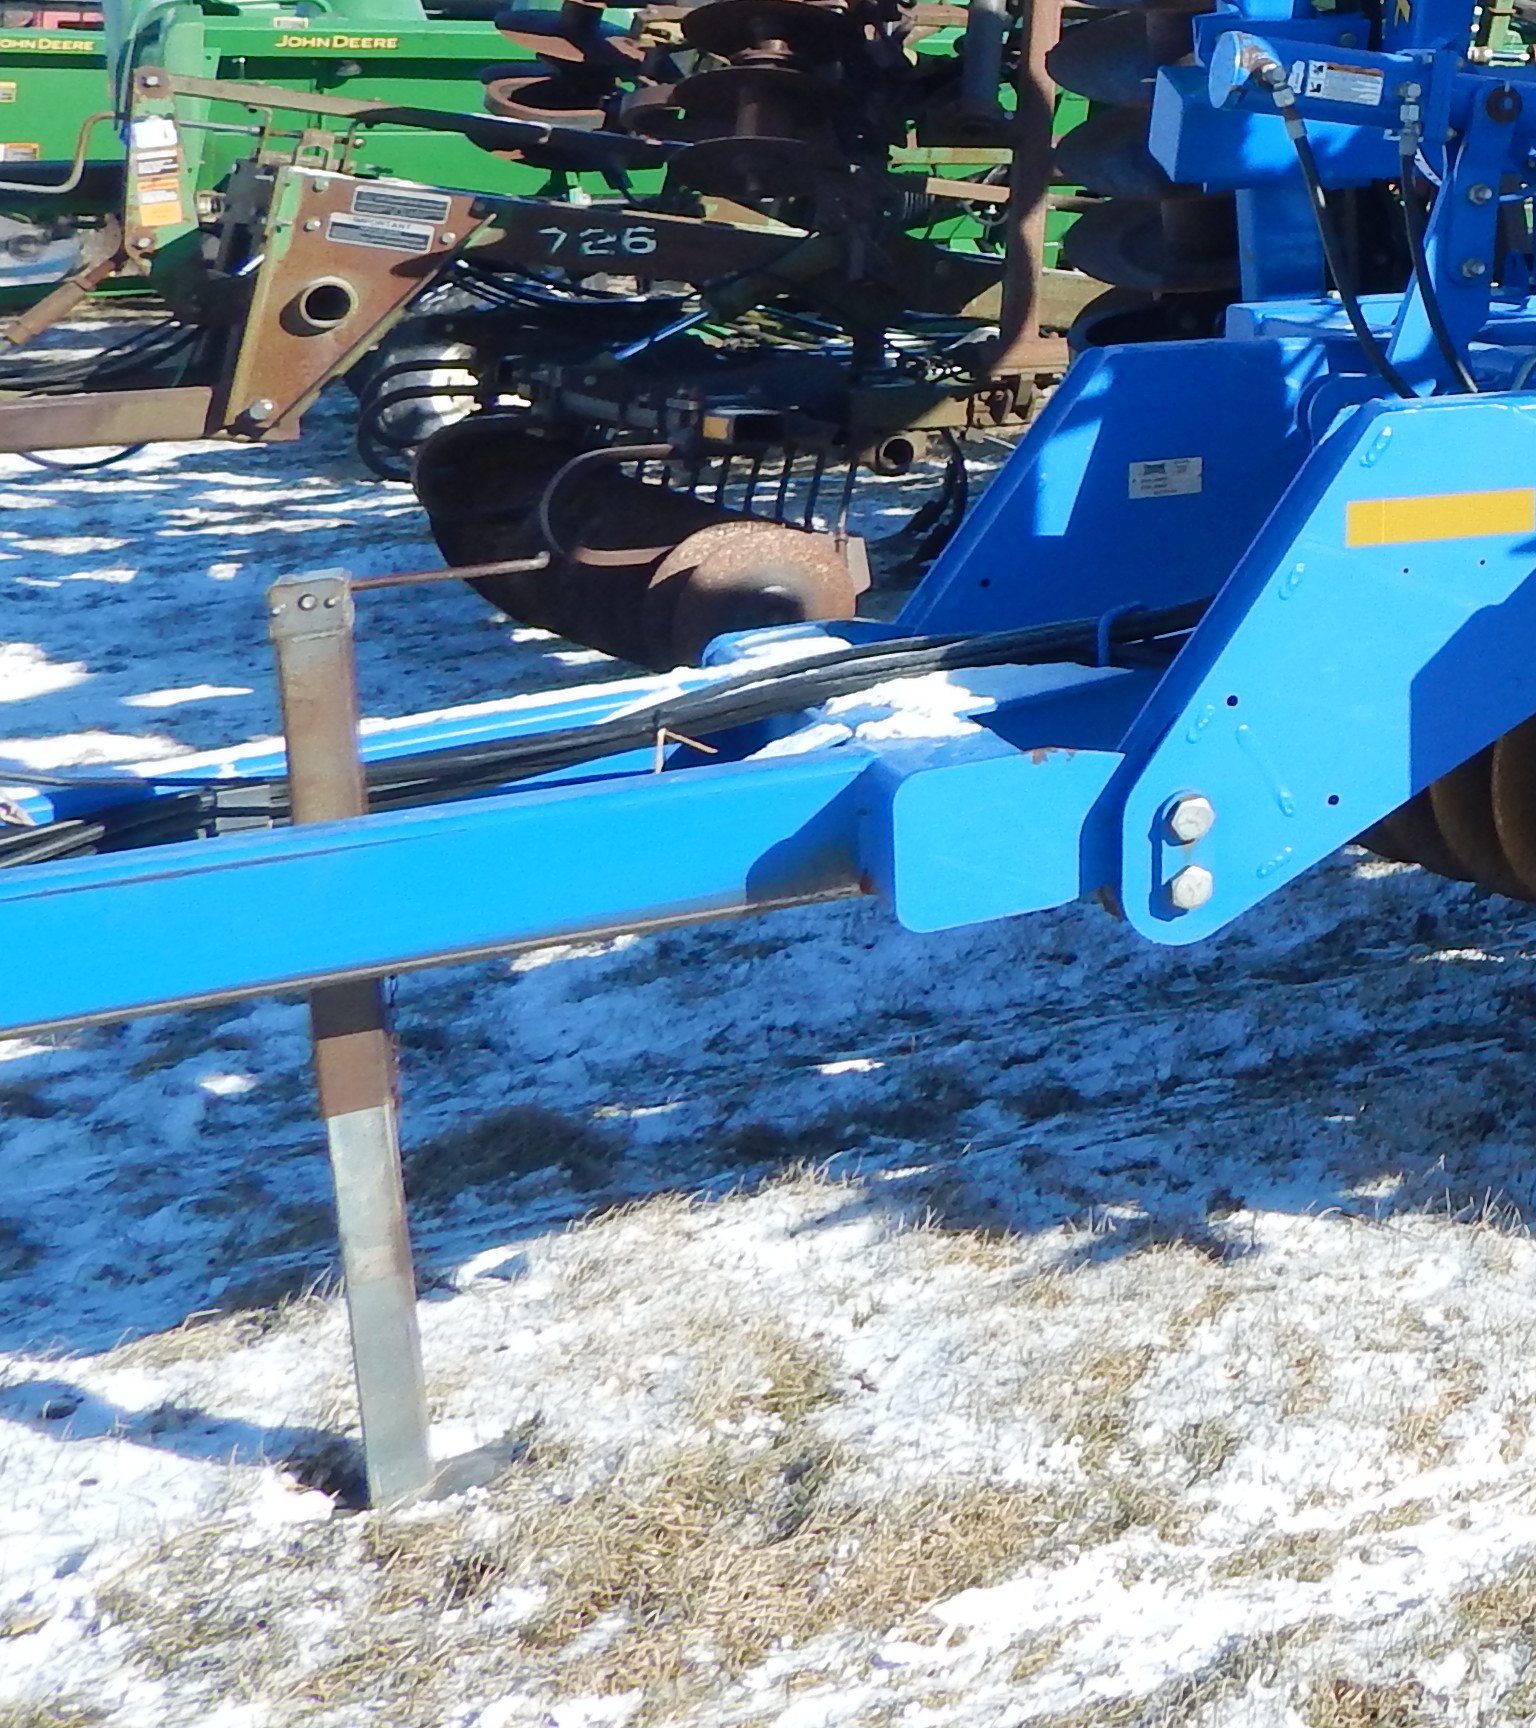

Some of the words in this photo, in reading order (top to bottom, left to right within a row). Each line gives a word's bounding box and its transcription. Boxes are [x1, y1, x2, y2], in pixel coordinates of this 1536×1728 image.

[0, 38, 36, 49] OHN
[37, 38, 95, 51] DEERE
[275, 34, 331, 48] JOHN
[332, 34, 399, 49] DEERE
[538, 226, 657, 255] 726
